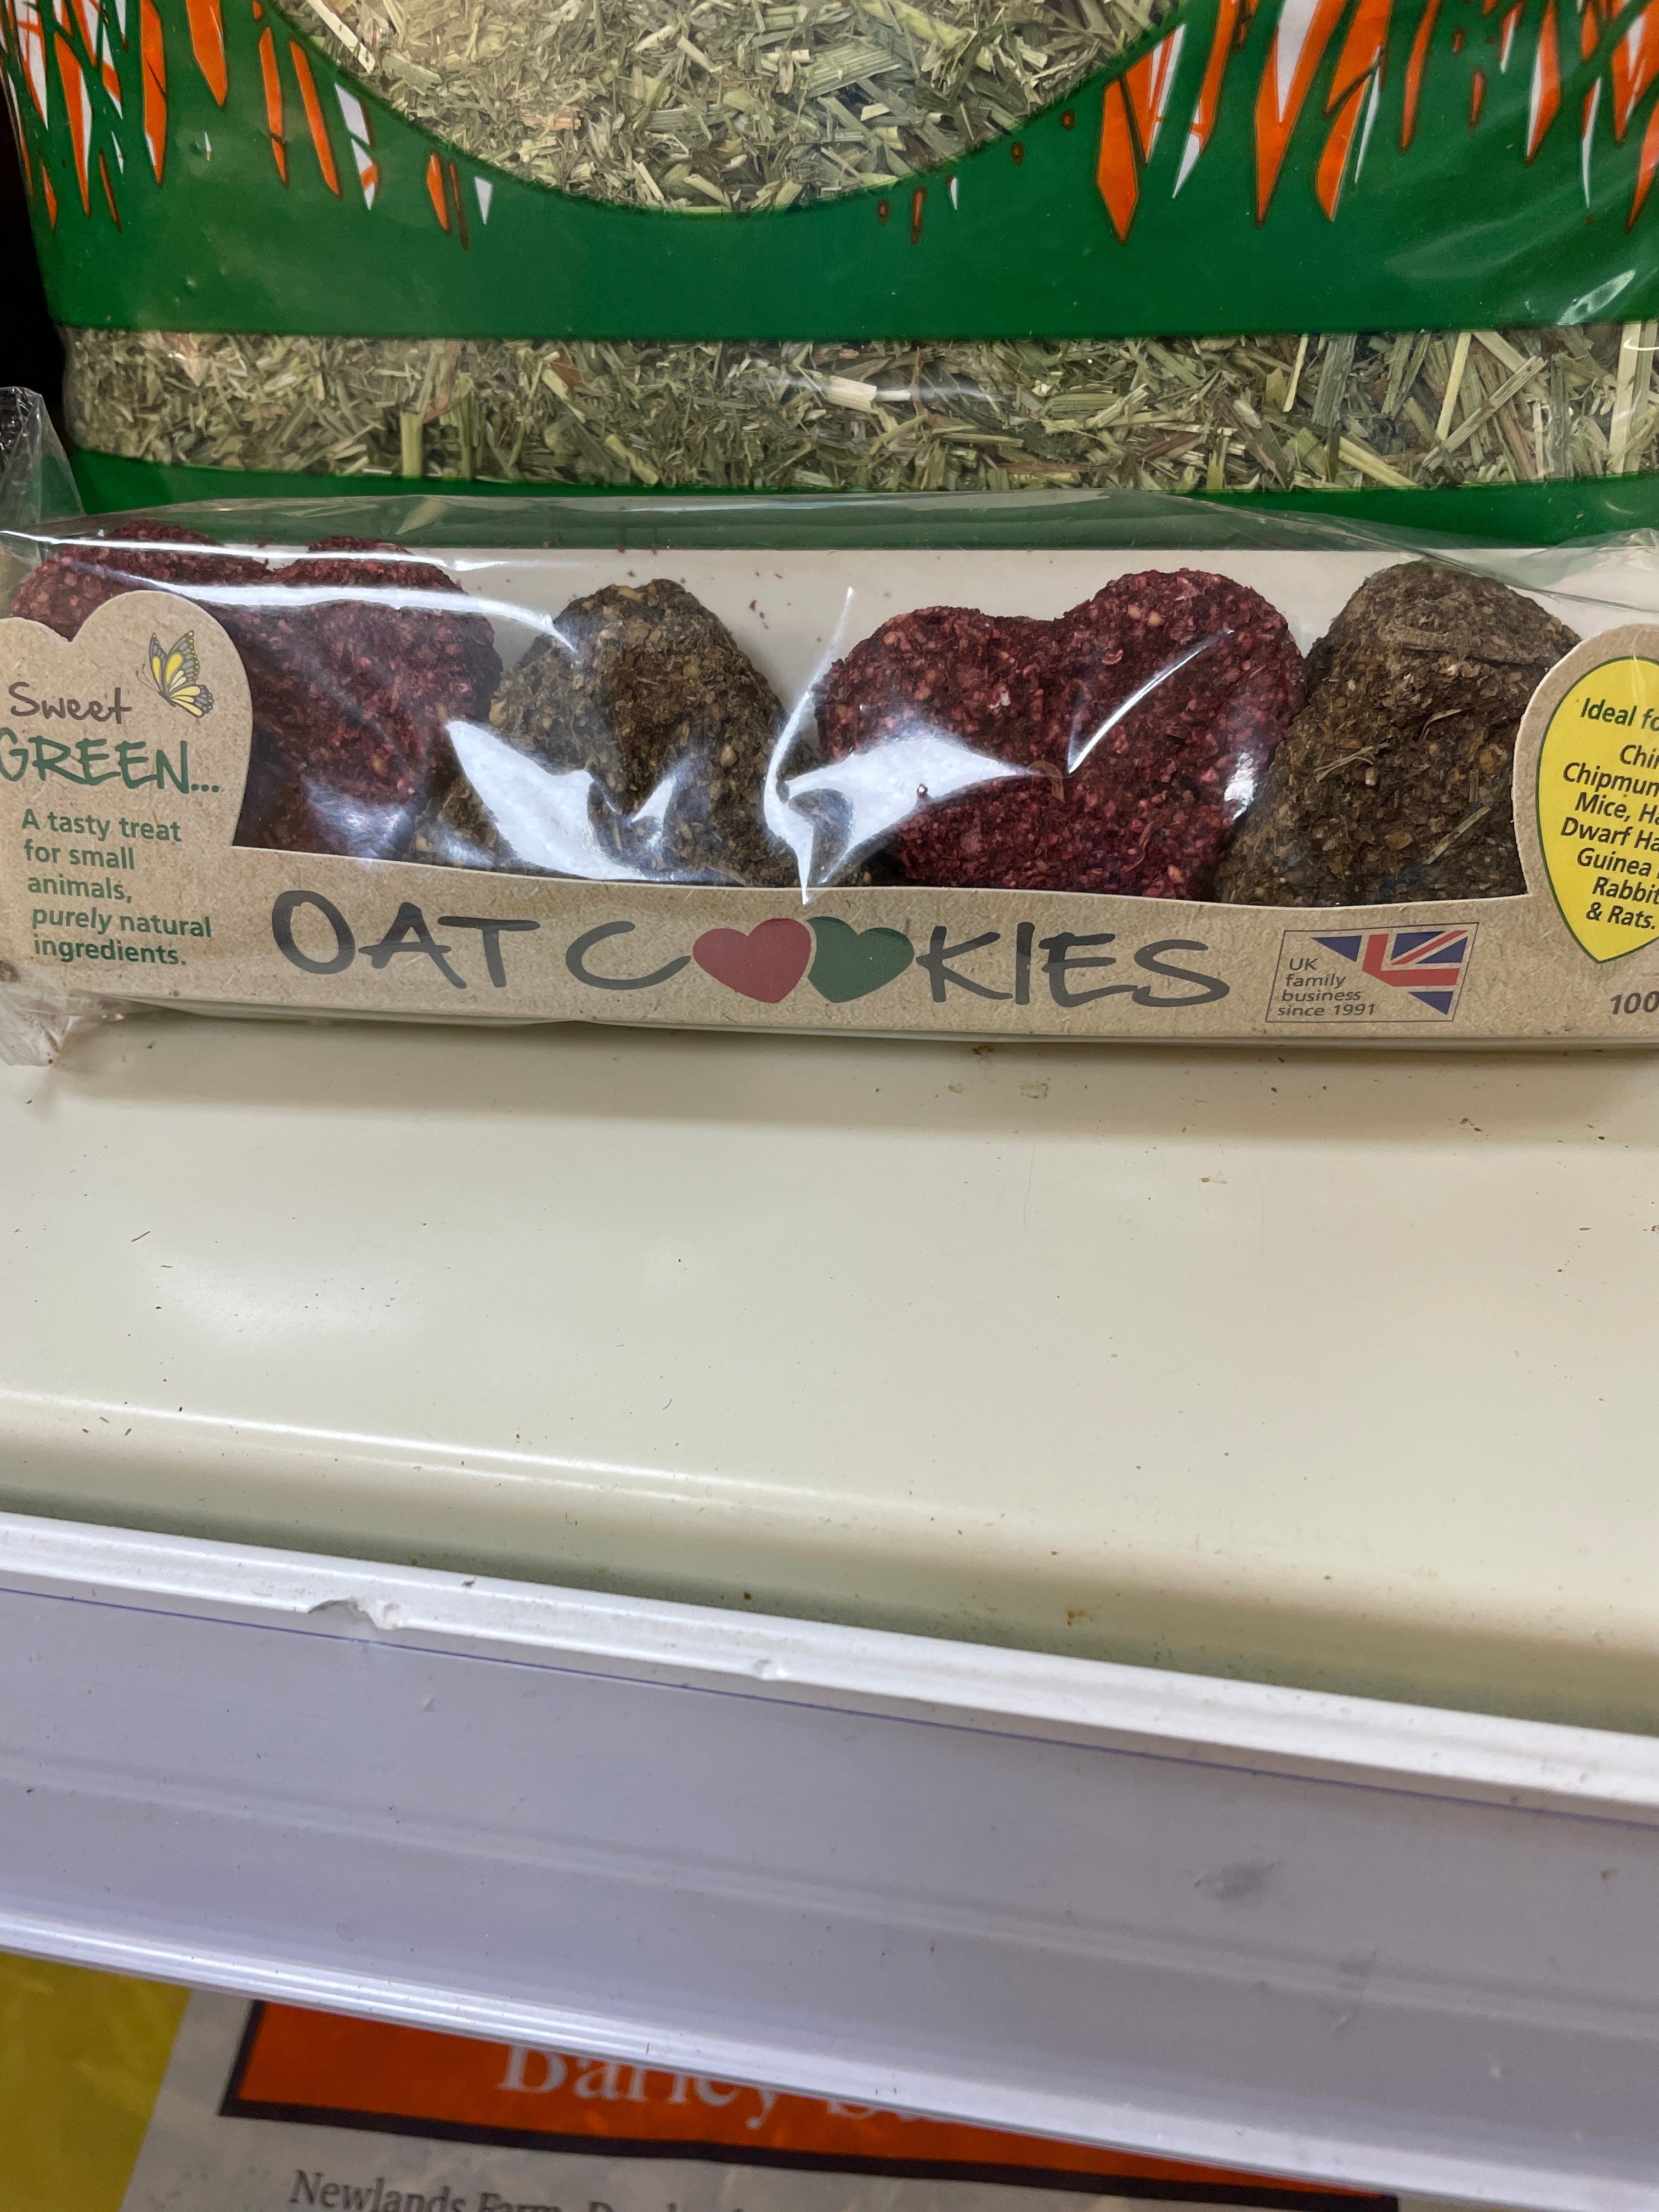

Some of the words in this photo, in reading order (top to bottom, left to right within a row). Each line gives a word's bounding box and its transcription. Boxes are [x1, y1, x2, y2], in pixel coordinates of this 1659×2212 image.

[9, 681, 132, 725] Sweet
[1580, 697, 1638, 727] Ideal
[1574, 791, 1632, 823] Mice,
[22, 809, 41, 831] A
[47, 811, 111, 841] tasty
[119, 816, 182, 842] treat
[1560, 816, 1633, 847] Dwarf
[25, 839, 61, 864] for
[70, 847, 134, 870] small
[1577, 847, 1652, 878] Guinea
[28, 873, 133, 904] animals,
[32, 907, 113, 936] purely
[119, 915, 212, 938] natural
[1585, 901, 1603, 922] &
[1607, 905, 1656, 930] Rats.
[33, 934, 187, 966] ingredients.
[272, 890, 541, 990] OAT
[1289, 958, 1319, 970] UK
[1282, 990, 1361, 1002] business
[1285, 973, 1347, 989] family
[1277, 1005, 1325, 1016] since
[1333, 1003, 1375, 1016] 1991
